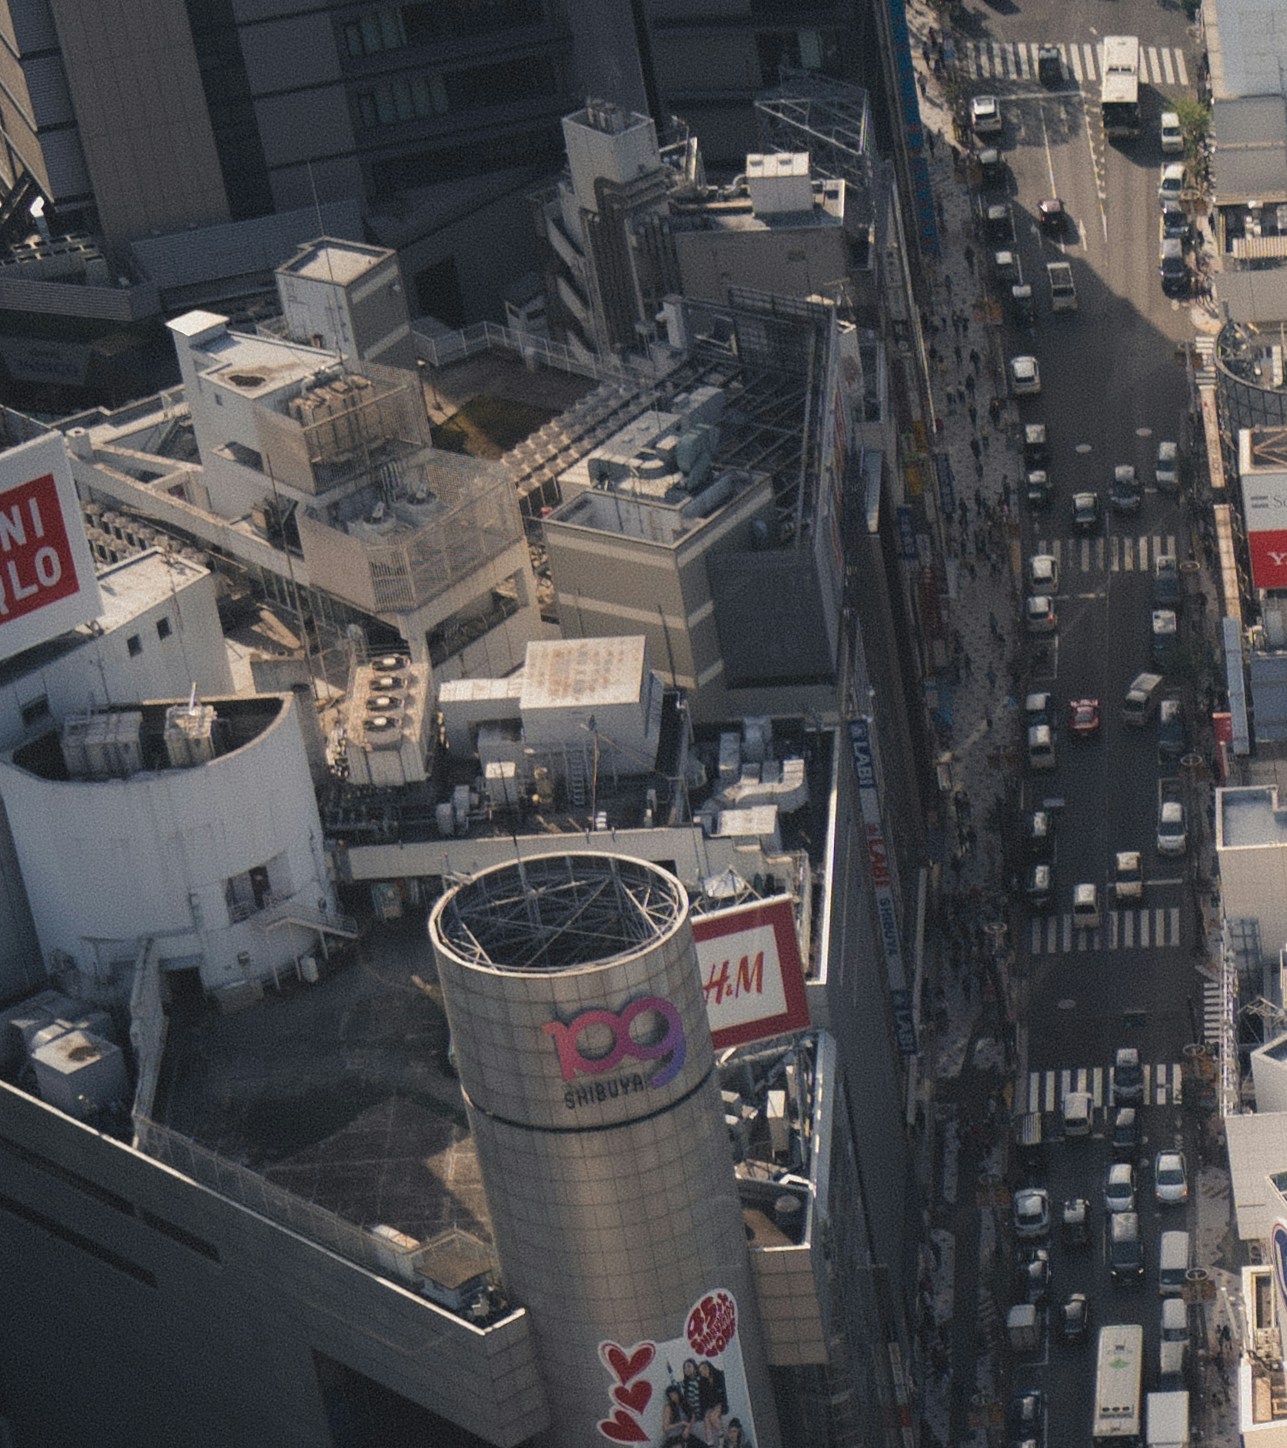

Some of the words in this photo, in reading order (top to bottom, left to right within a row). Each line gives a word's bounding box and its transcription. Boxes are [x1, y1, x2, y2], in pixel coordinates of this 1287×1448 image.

[703, 951, 764, 1005] H&M
[541, 996, 685, 1089] 109
[564, 1070, 647, 1110] SHIBUYA
